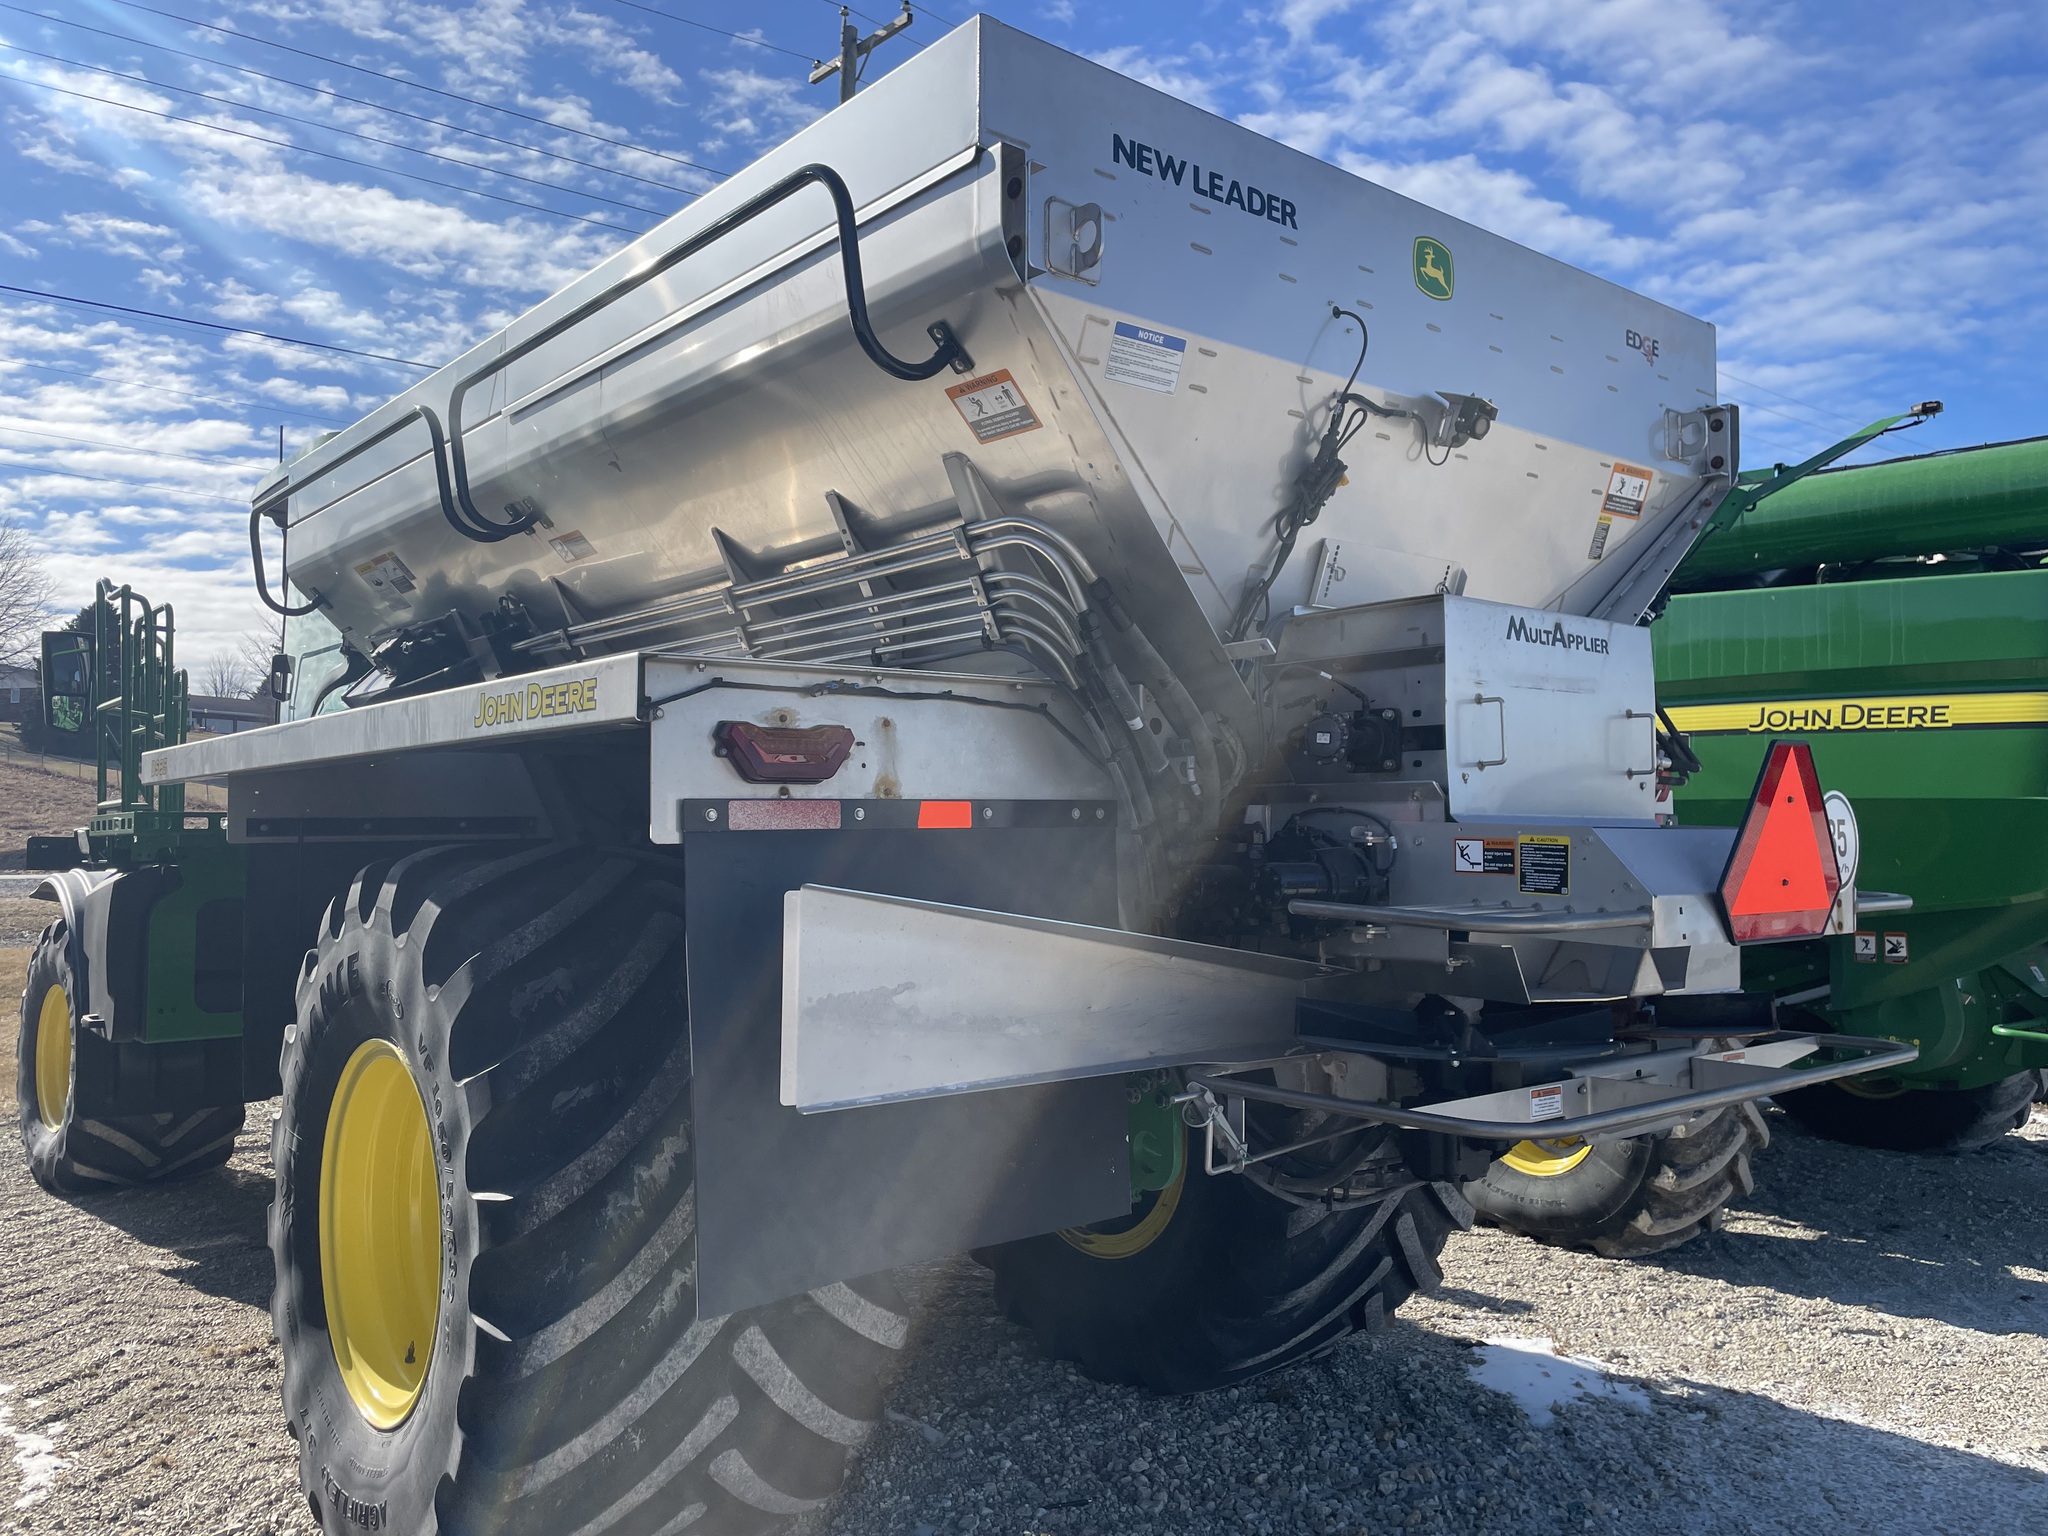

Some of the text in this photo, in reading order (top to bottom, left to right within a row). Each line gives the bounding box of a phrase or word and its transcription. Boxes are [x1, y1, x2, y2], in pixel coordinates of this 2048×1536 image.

[1112, 133, 1298, 231] NEW LEADER
[1137, 330, 1165, 344] NOTICE
[1625, 329, 1659, 358] EDGE
[965, 375, 998, 390] WARNING
[474, 677, 598, 728] JOHN DEERE
[1749, 704, 1950, 728] JOHN DEERE
